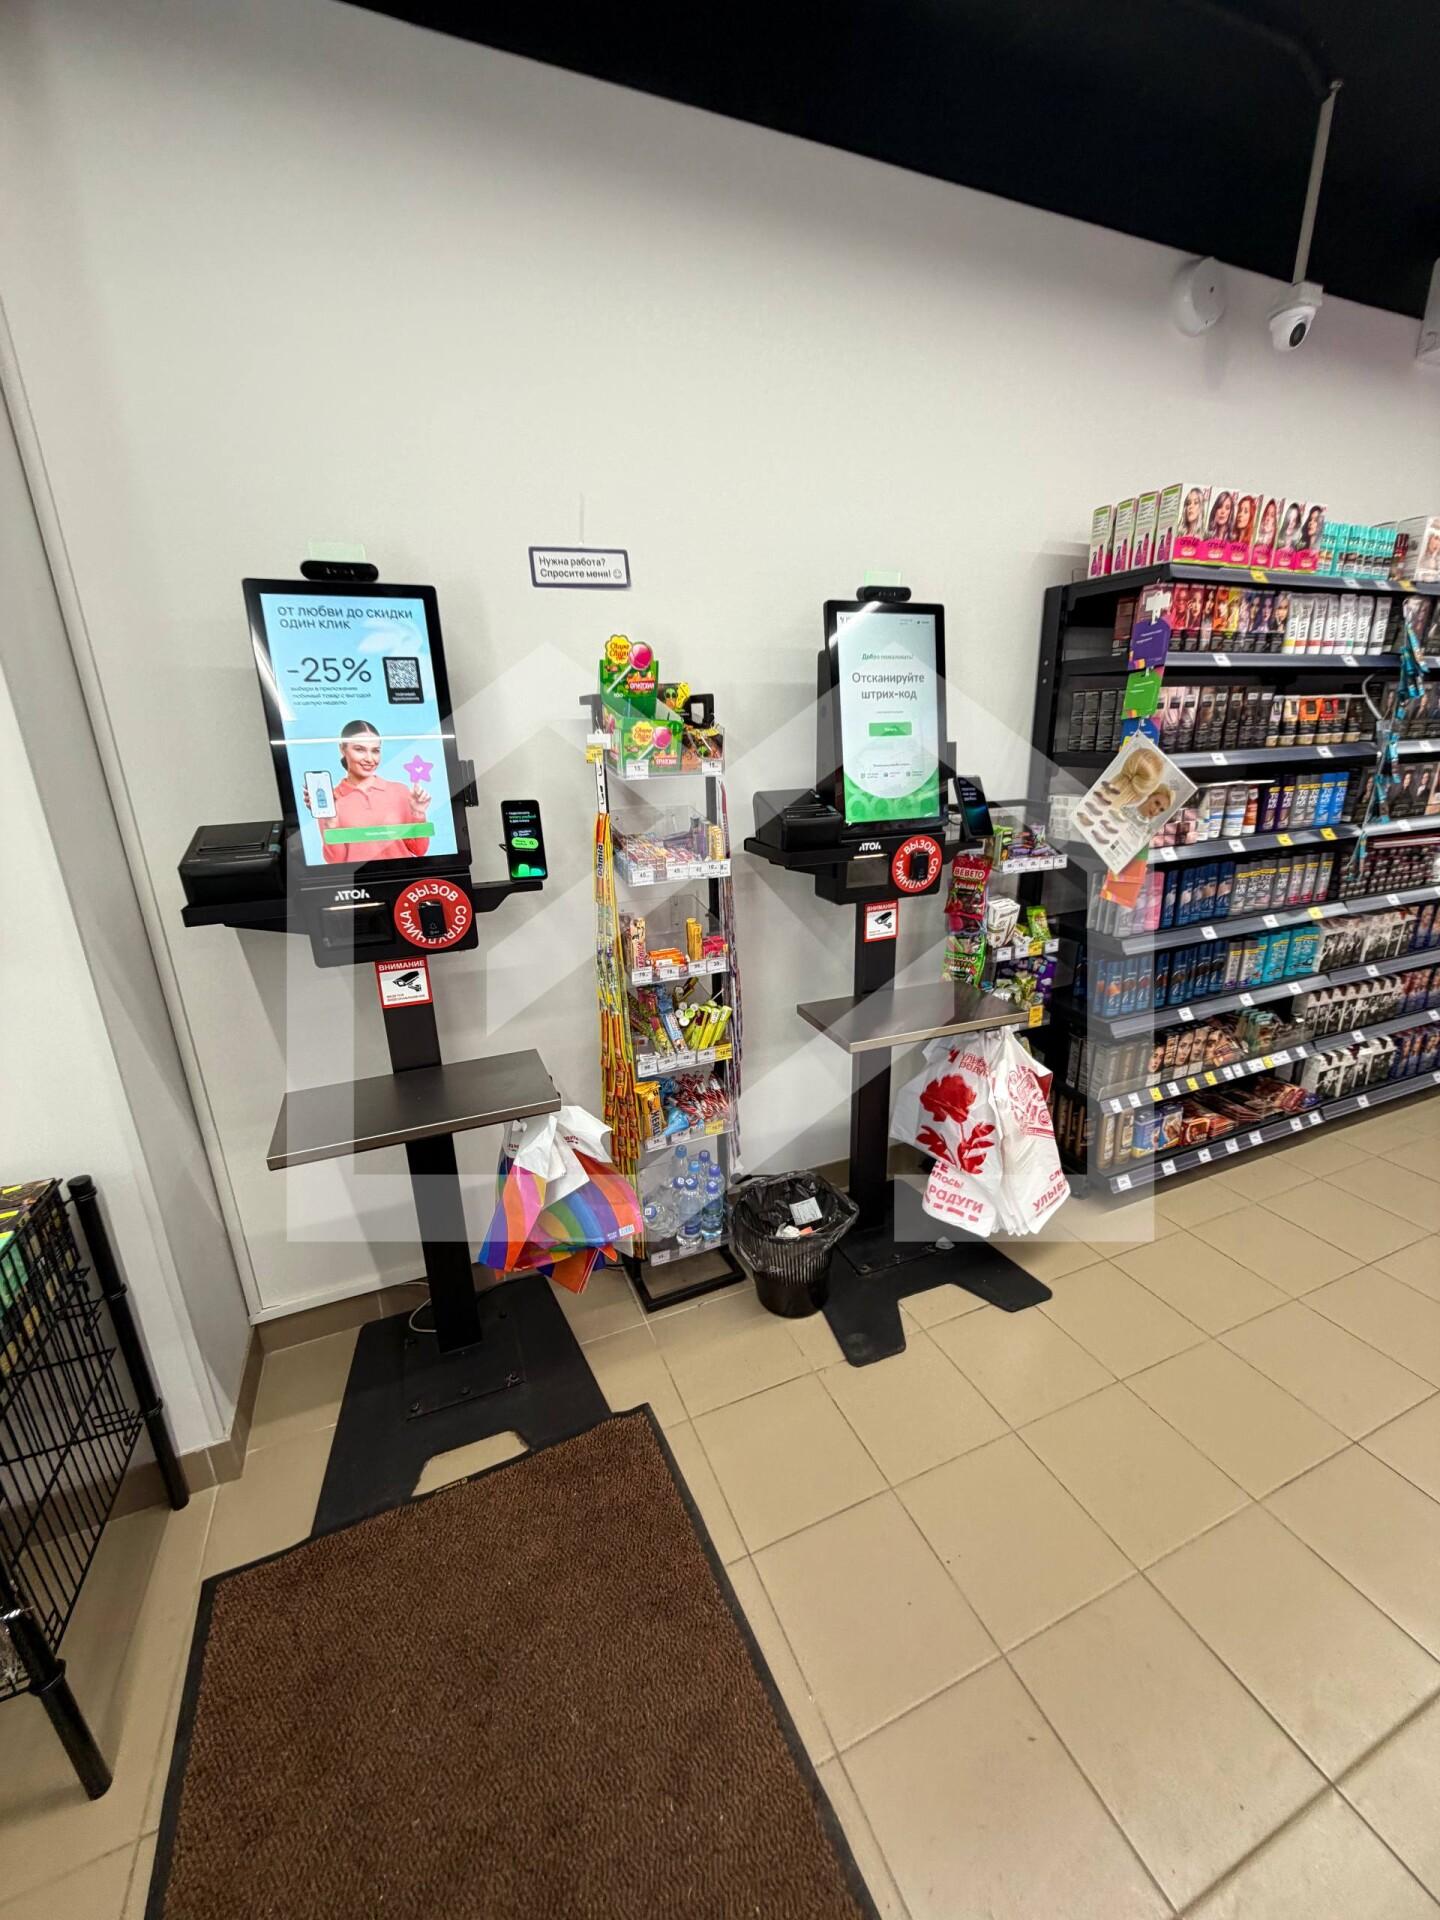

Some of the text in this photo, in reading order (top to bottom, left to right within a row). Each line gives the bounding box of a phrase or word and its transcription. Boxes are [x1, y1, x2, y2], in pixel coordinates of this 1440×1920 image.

[538, 555, 606, 568] Нужна работа?
[540, 568, 611, 580] Спросите меня!
[287, 657, 372, 683] -25%
[852, 672, 925, 685] Отсканируйте
[861, 690, 918, 700] штрих-код
[903, 839, 936, 855] ВЫЗОВ
[953, 867, 985, 880] BEBETO
[406, 883, 459, 903] ВЫЗОВ
[378, 959, 425, 972] ВНИМАНИЕ
